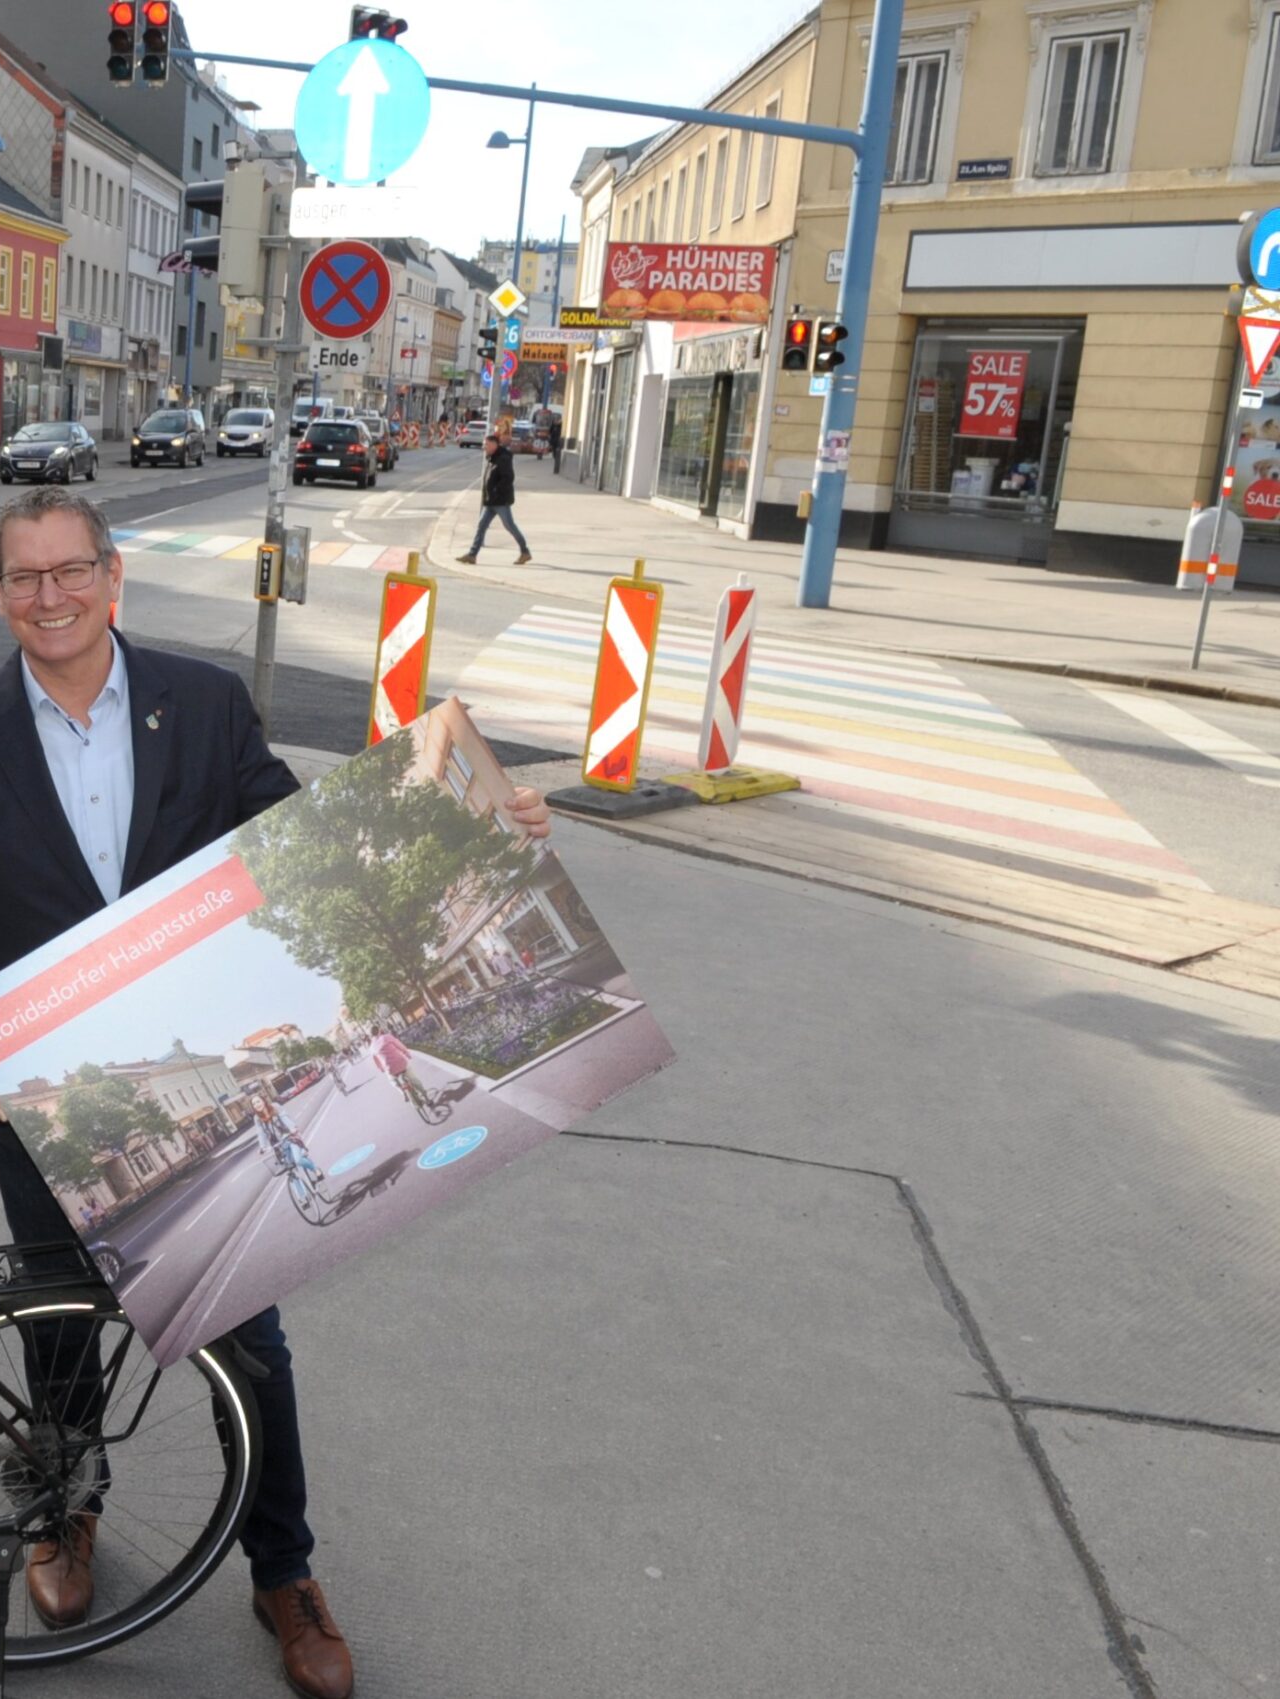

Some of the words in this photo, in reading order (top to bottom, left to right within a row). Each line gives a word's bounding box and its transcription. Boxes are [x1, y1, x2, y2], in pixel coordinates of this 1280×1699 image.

[666, 246, 764, 272] HÜHNER
[648, 271, 762, 293] PARADIES
[319, 347, 359, 367] Ende
[971, 355, 1022, 376] SALE
[107, 886, 234, 972] Hauptstraße
